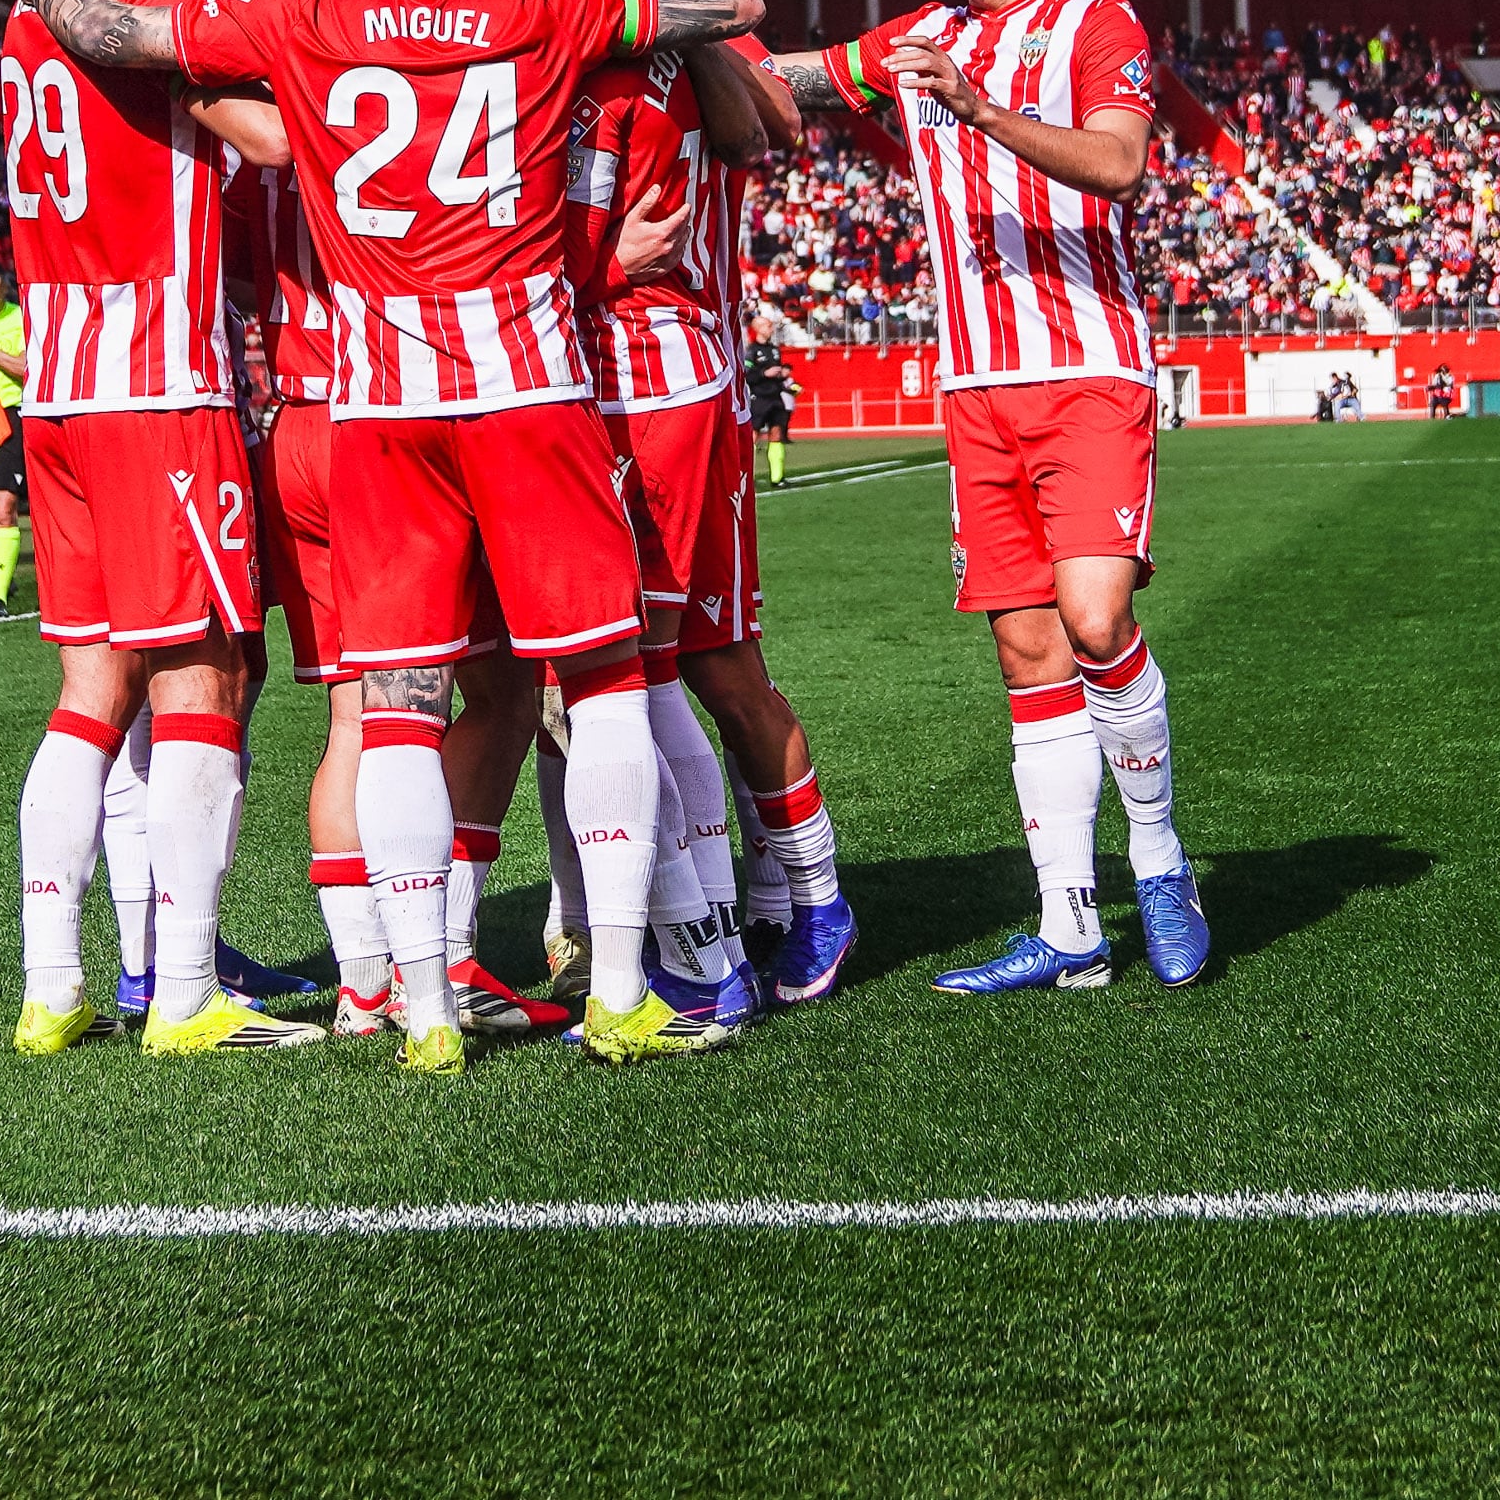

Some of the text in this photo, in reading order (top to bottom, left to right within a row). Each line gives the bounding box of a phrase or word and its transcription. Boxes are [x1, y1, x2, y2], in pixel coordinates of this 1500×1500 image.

[363, 6, 491, 48] MIGUEL
[0, 56, 88, 223] 29
[325, 61, 523, 239] 24
[1113, 754, 1161, 772] UDA
[578, 828, 630, 845] UDA
[23, 880, 60, 895] UDA
[392, 875, 446, 894] UDA
